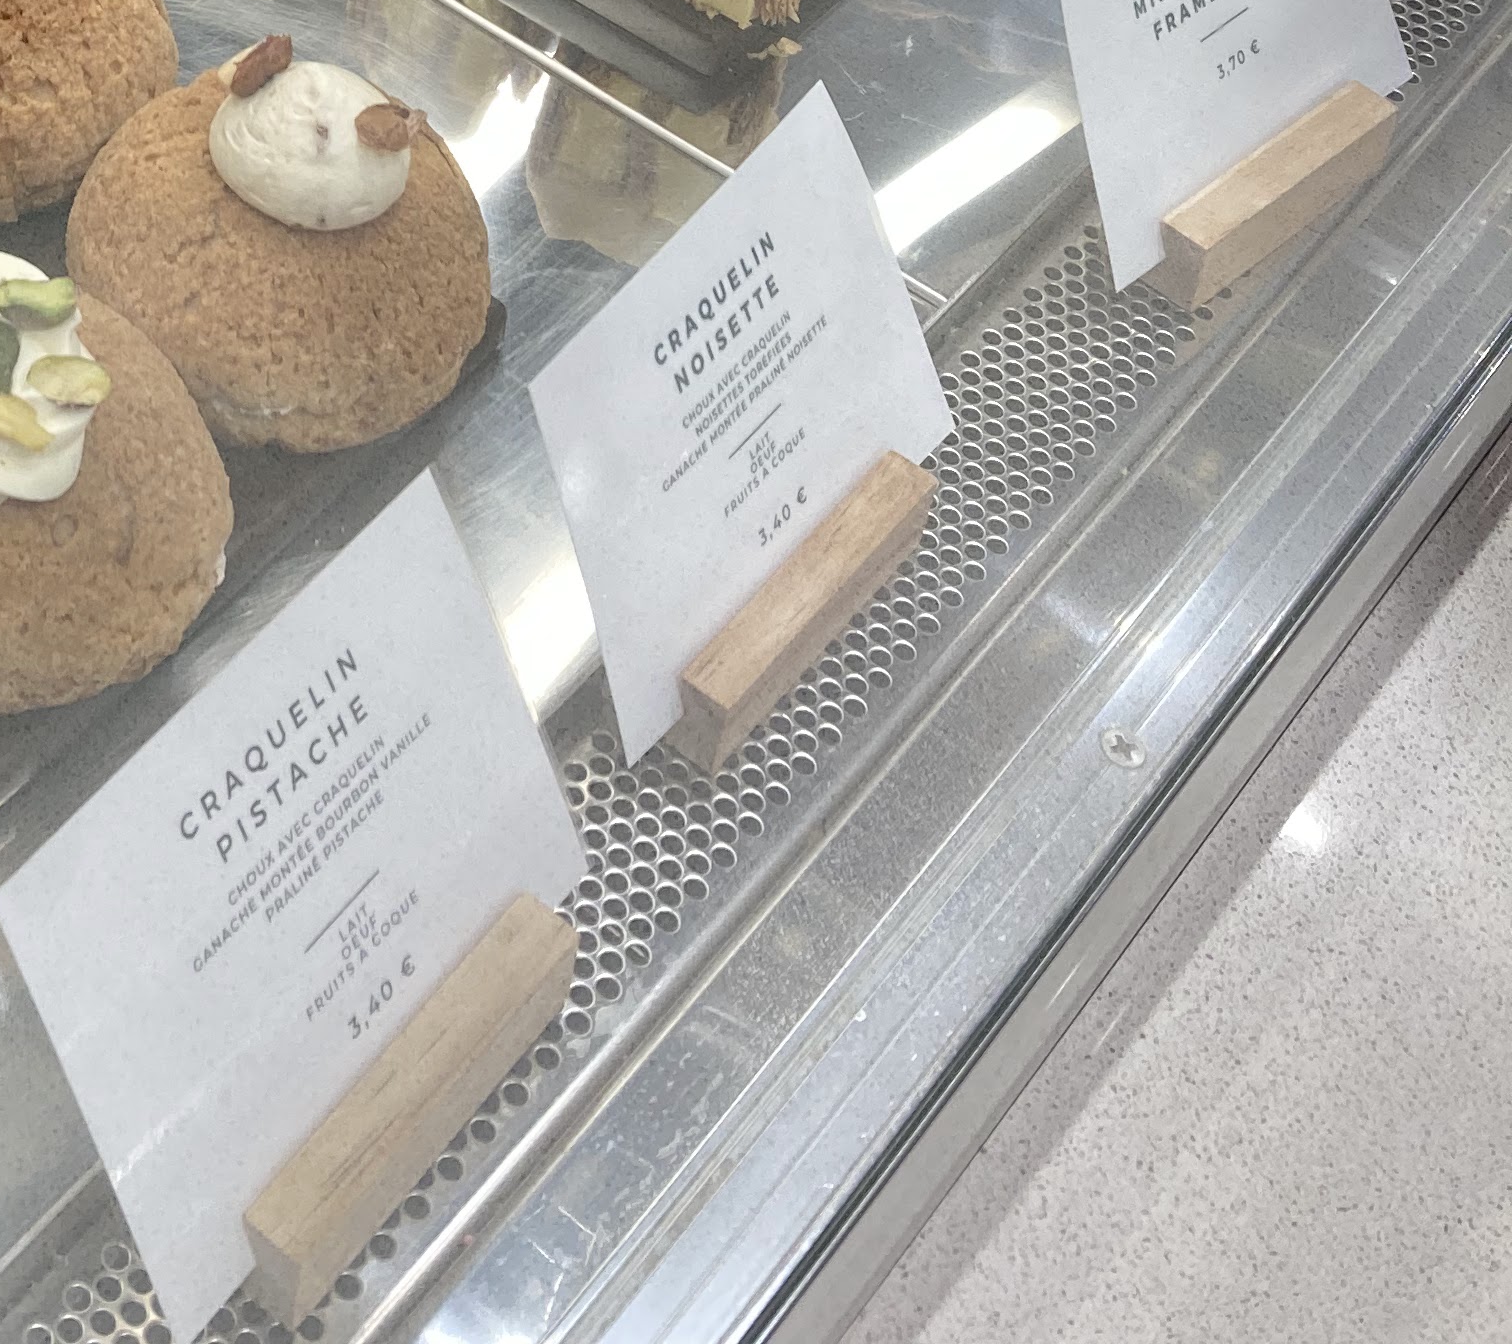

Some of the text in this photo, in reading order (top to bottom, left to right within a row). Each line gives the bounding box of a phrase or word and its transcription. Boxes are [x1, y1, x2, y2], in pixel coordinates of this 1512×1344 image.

[1216, 39, 1260, 79] 3,70 €
[654, 231, 775, 366] CRAQUELIN
[673, 274, 779, 393] NOISETTE
[662, 315, 827, 492] GANACHE MONTÉE PRALINÉ NOISETTE
[682, 311, 791, 429] CHOUX AVEC CRAQUELIN
[695, 384, 744, 437] NOISETTES
[724, 476, 760, 518] FRUITS
[771, 427, 805, 468] COQUE
[749, 431, 769, 460] LAIT
[750, 440, 775, 473] OEUF
[758, 486, 807, 546] 3,40 €
[180, 648, 357, 840] CRAQUELIN
[216, 695, 368, 863] PISTACHE
[193, 712, 431, 972] GANACHE MONTÉE BOURBON VANILLE
[228, 735, 385, 906] CHOUX AVEC CRAQUELIN
[265, 789, 385, 923] PRALINÉ PISTACHE
[306, 962, 354, 1022] FRUITS
[371, 889, 419, 947] COQUE
[339, 902, 367, 942] LAIT
[341, 909, 376, 960] OEUF
[348, 954, 415, 1039] 3,40 €
